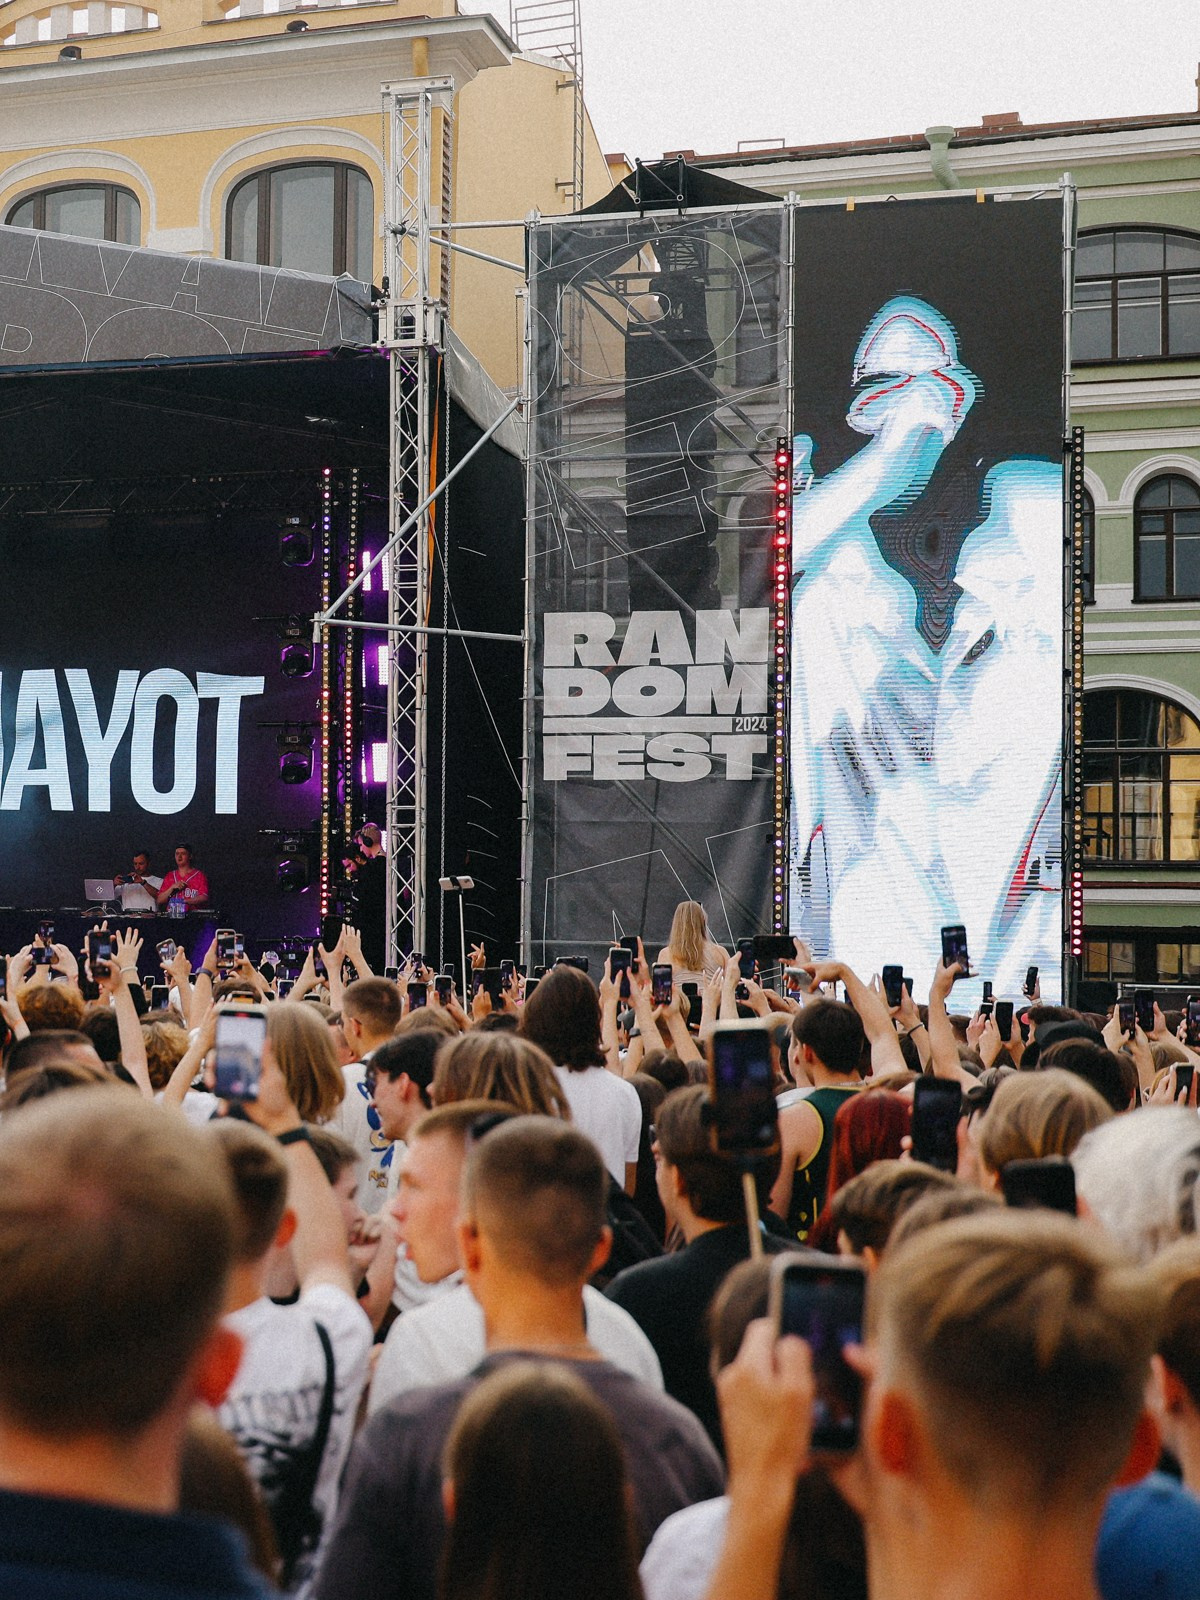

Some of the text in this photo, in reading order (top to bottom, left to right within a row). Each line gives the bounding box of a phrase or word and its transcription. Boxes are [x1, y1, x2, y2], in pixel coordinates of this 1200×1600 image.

[543, 607, 770, 667] RAN
[543, 664, 768, 717] DOM
[735, 716, 768, 732] 2024
[543, 733, 768, 782] FEST
